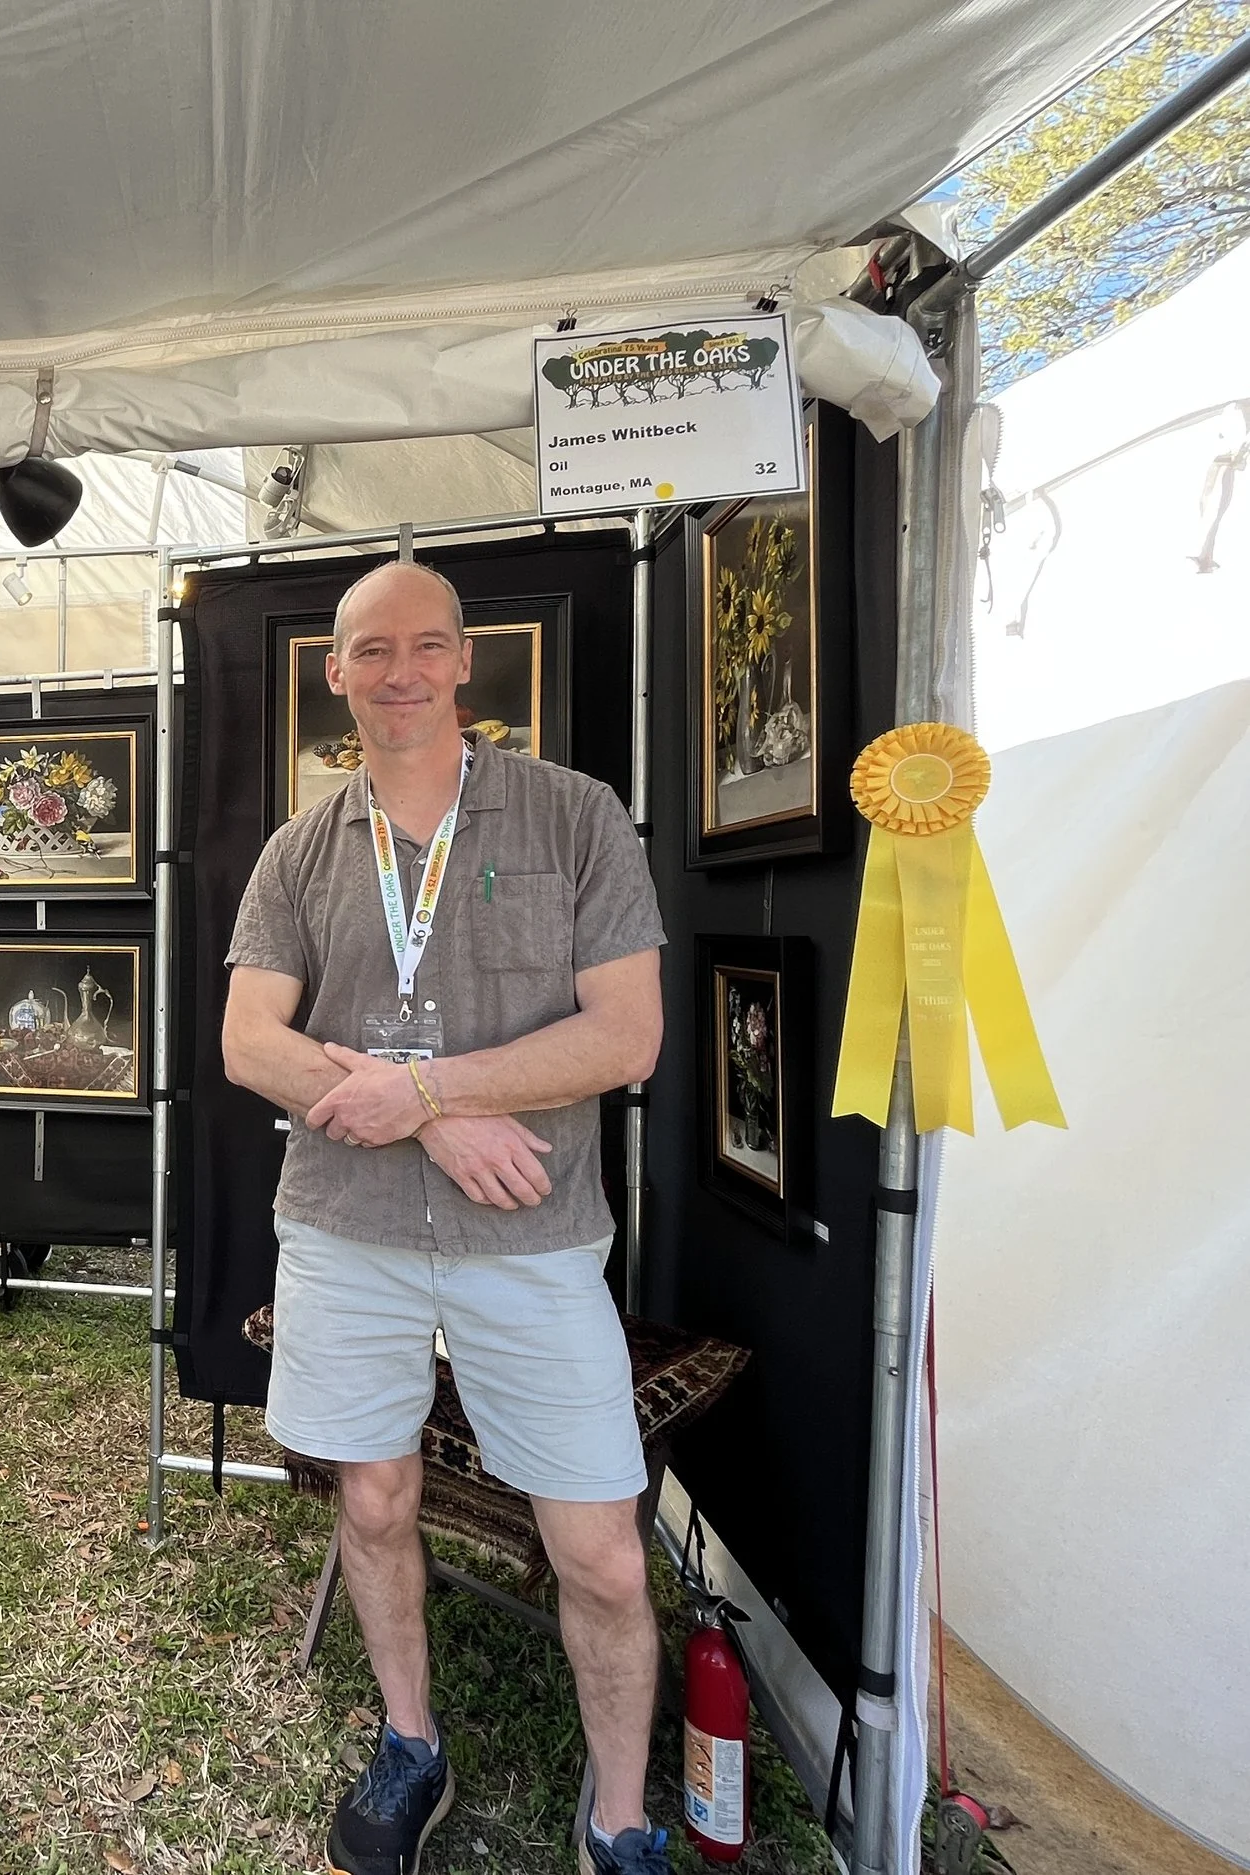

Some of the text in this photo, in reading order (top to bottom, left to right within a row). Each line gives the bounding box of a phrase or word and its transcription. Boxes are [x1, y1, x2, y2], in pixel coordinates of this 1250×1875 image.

[570, 344, 751, 380] UNDER THE OAKS
[578, 346, 623, 360] Celebrating
[636, 343, 659, 352] Years
[548, 421, 698, 449] James Whitbeck
[549, 461, 569, 472] Oil
[754, 461, 778, 475] 32
[550, 477, 653, 497] Montague, MA
[440, 815, 454, 839] OAKS
[383, 873, 397, 898] OAKS
[388, 900, 400, 920] THE
[391, 920, 406, 953] UNDER
